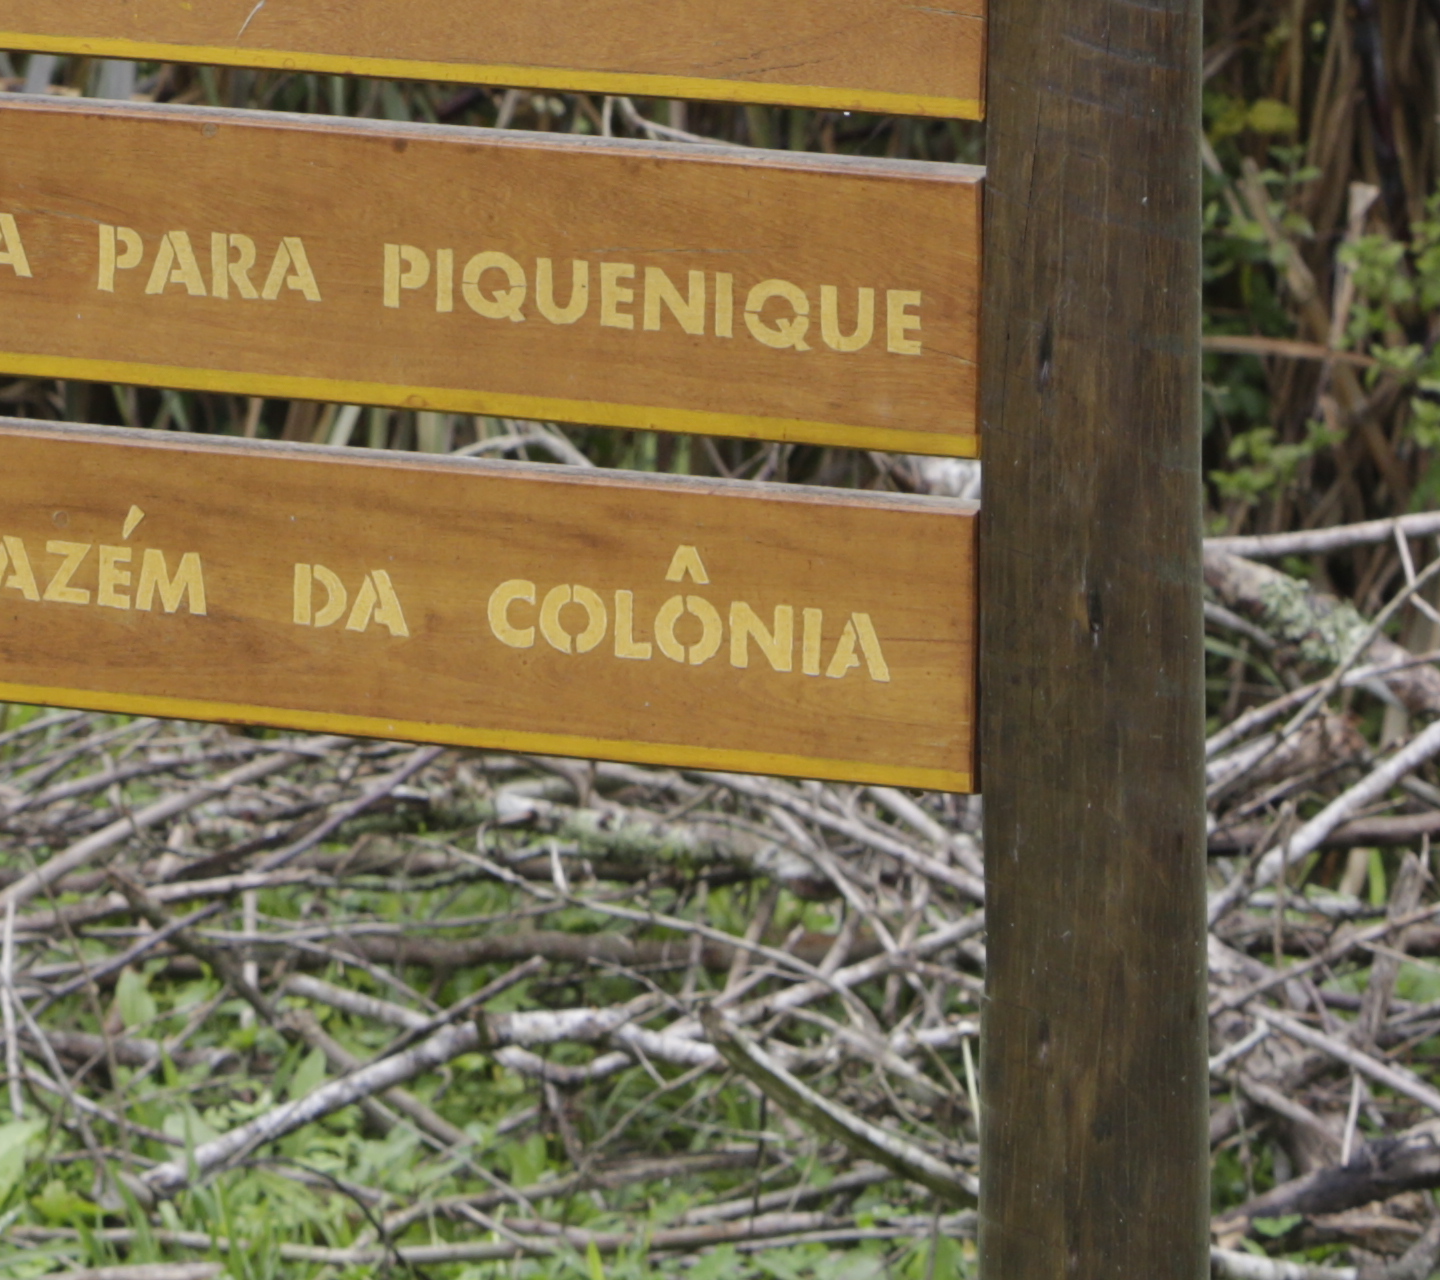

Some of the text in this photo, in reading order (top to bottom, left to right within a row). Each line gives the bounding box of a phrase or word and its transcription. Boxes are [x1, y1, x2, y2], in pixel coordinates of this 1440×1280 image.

[96, 223, 322, 302] PARA
[383, 243, 923, 355] PIQUENIQUE
[292, 563, 410, 638] DA
[487, 545, 891, 682] COLÔNIA
